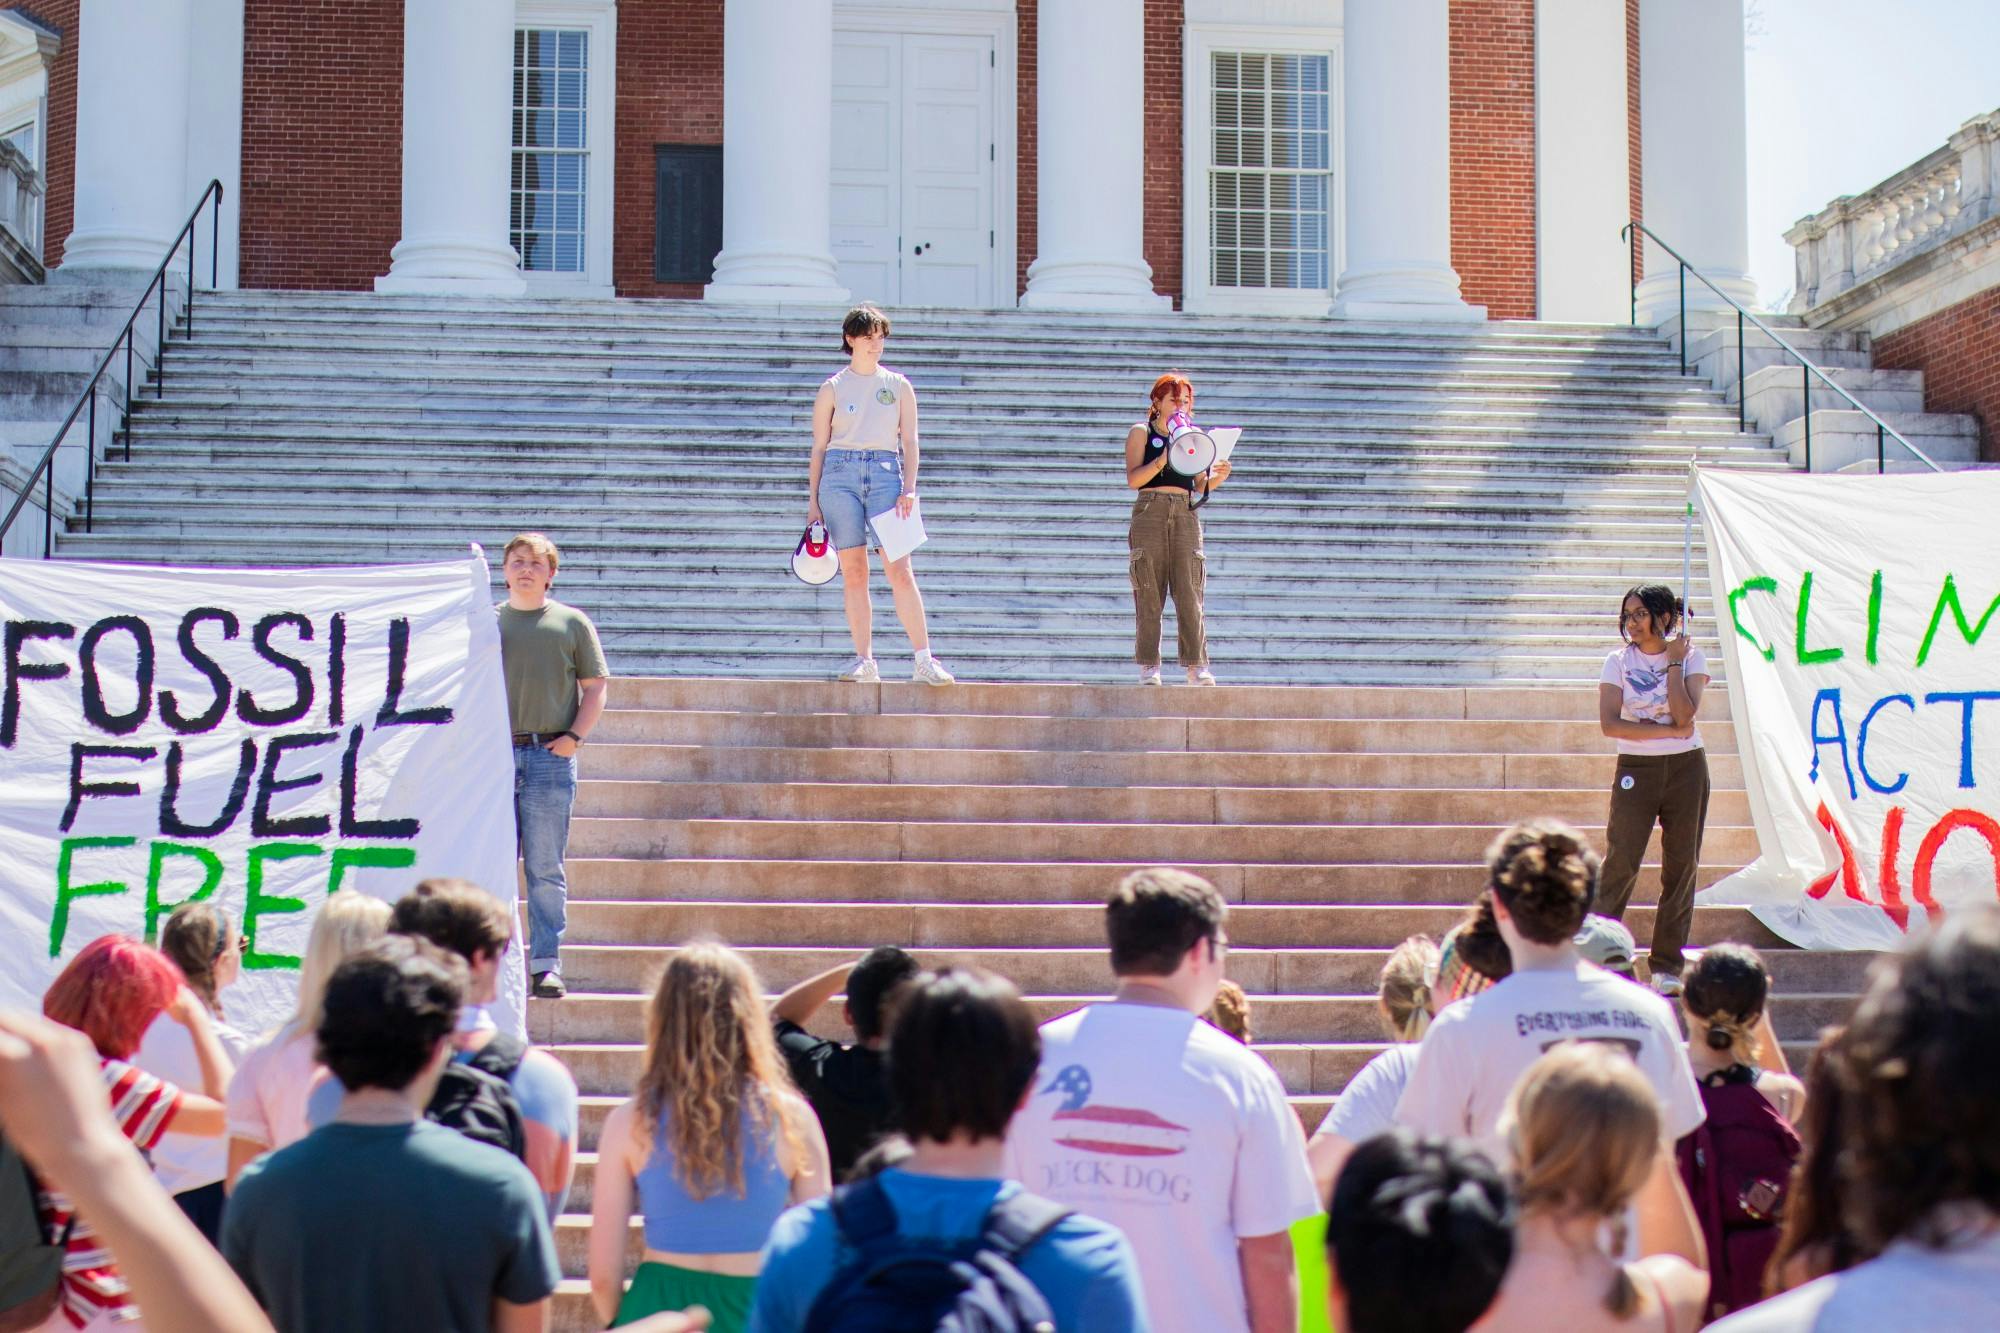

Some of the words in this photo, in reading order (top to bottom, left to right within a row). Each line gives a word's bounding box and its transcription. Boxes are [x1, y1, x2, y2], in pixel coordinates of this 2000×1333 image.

[1728, 568, 2000, 668] CLIM
[0, 607, 455, 748] FOSSIL
[58, 723, 421, 839] FUEL
[1809, 687, 2000, 800] ACT
[1122, 1163, 1192, 1203] DOG
